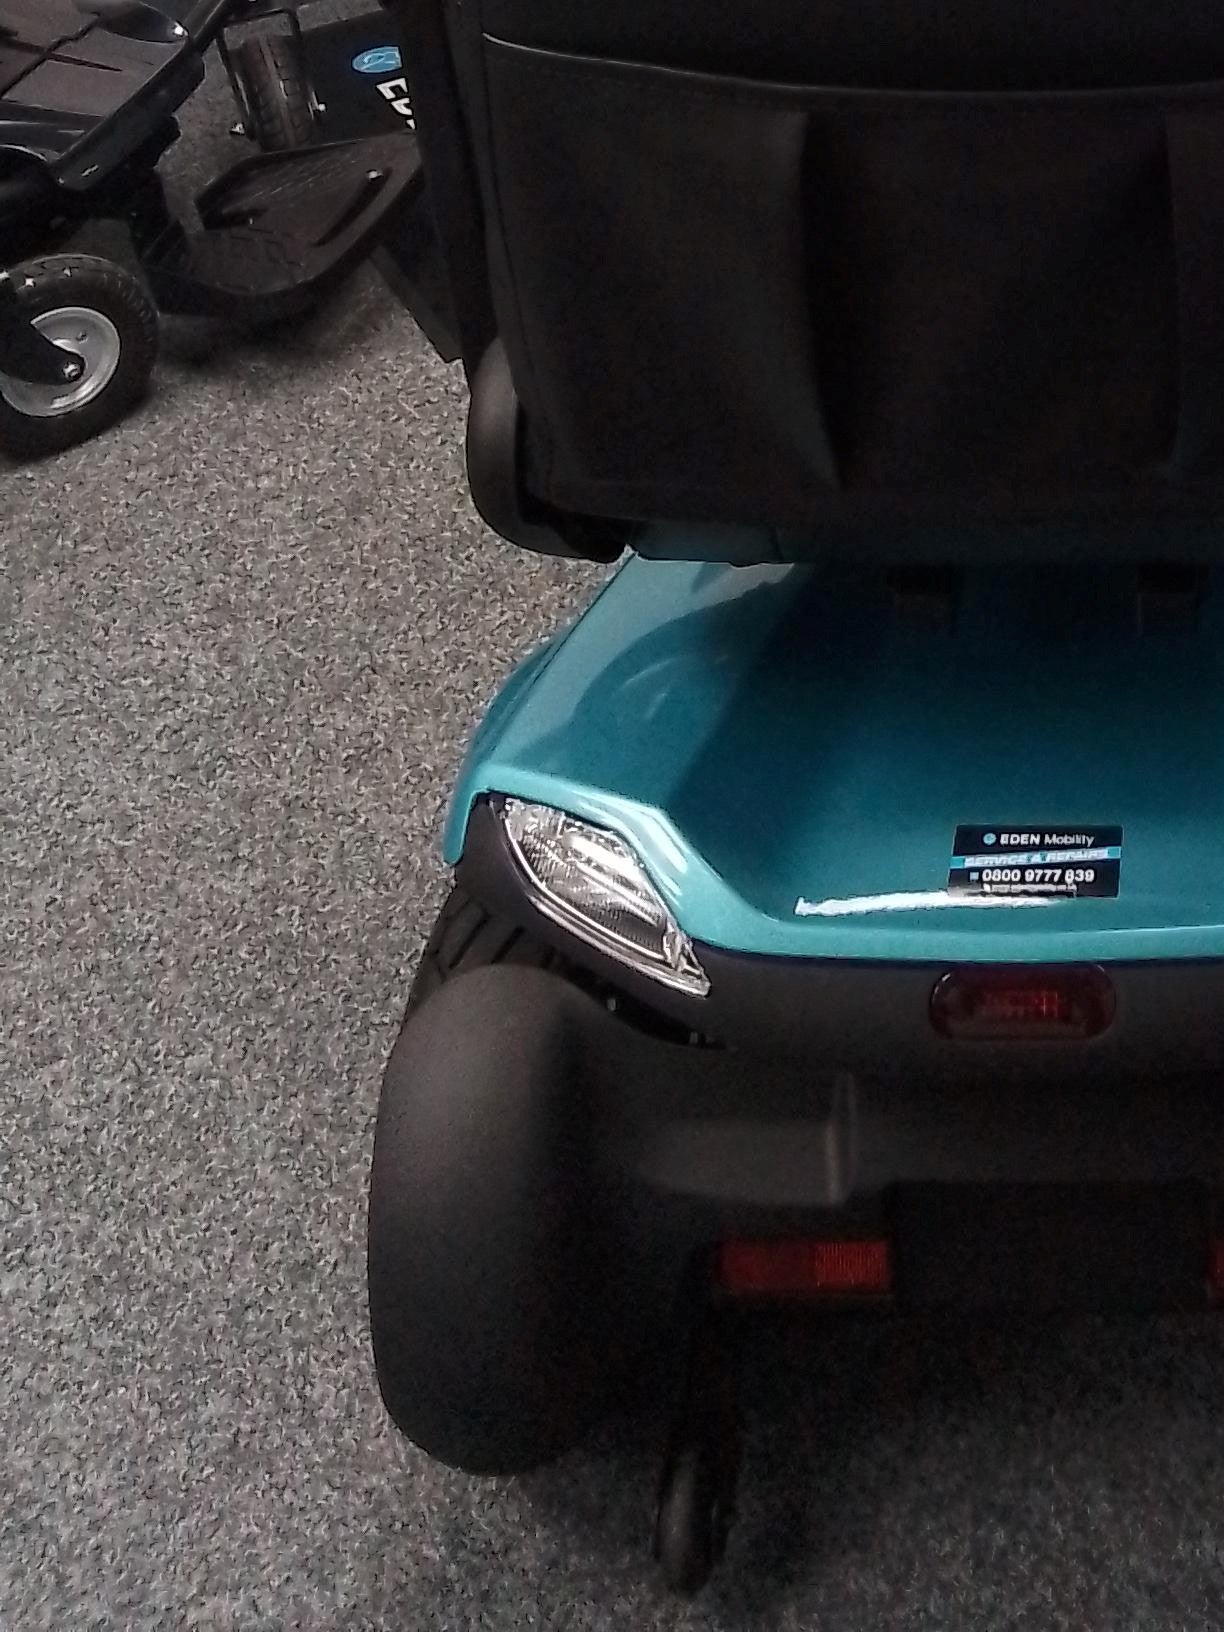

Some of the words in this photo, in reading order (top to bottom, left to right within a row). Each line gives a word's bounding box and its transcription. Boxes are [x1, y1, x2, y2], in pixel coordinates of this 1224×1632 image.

[999, 833, 1041, 846] EDEN
[1044, 833, 1095, 847] Mobility
[981, 869, 1021, 882] 0800
[1024, 869, 1061, 882] 9777
[1064, 869, 1095, 883] 839
